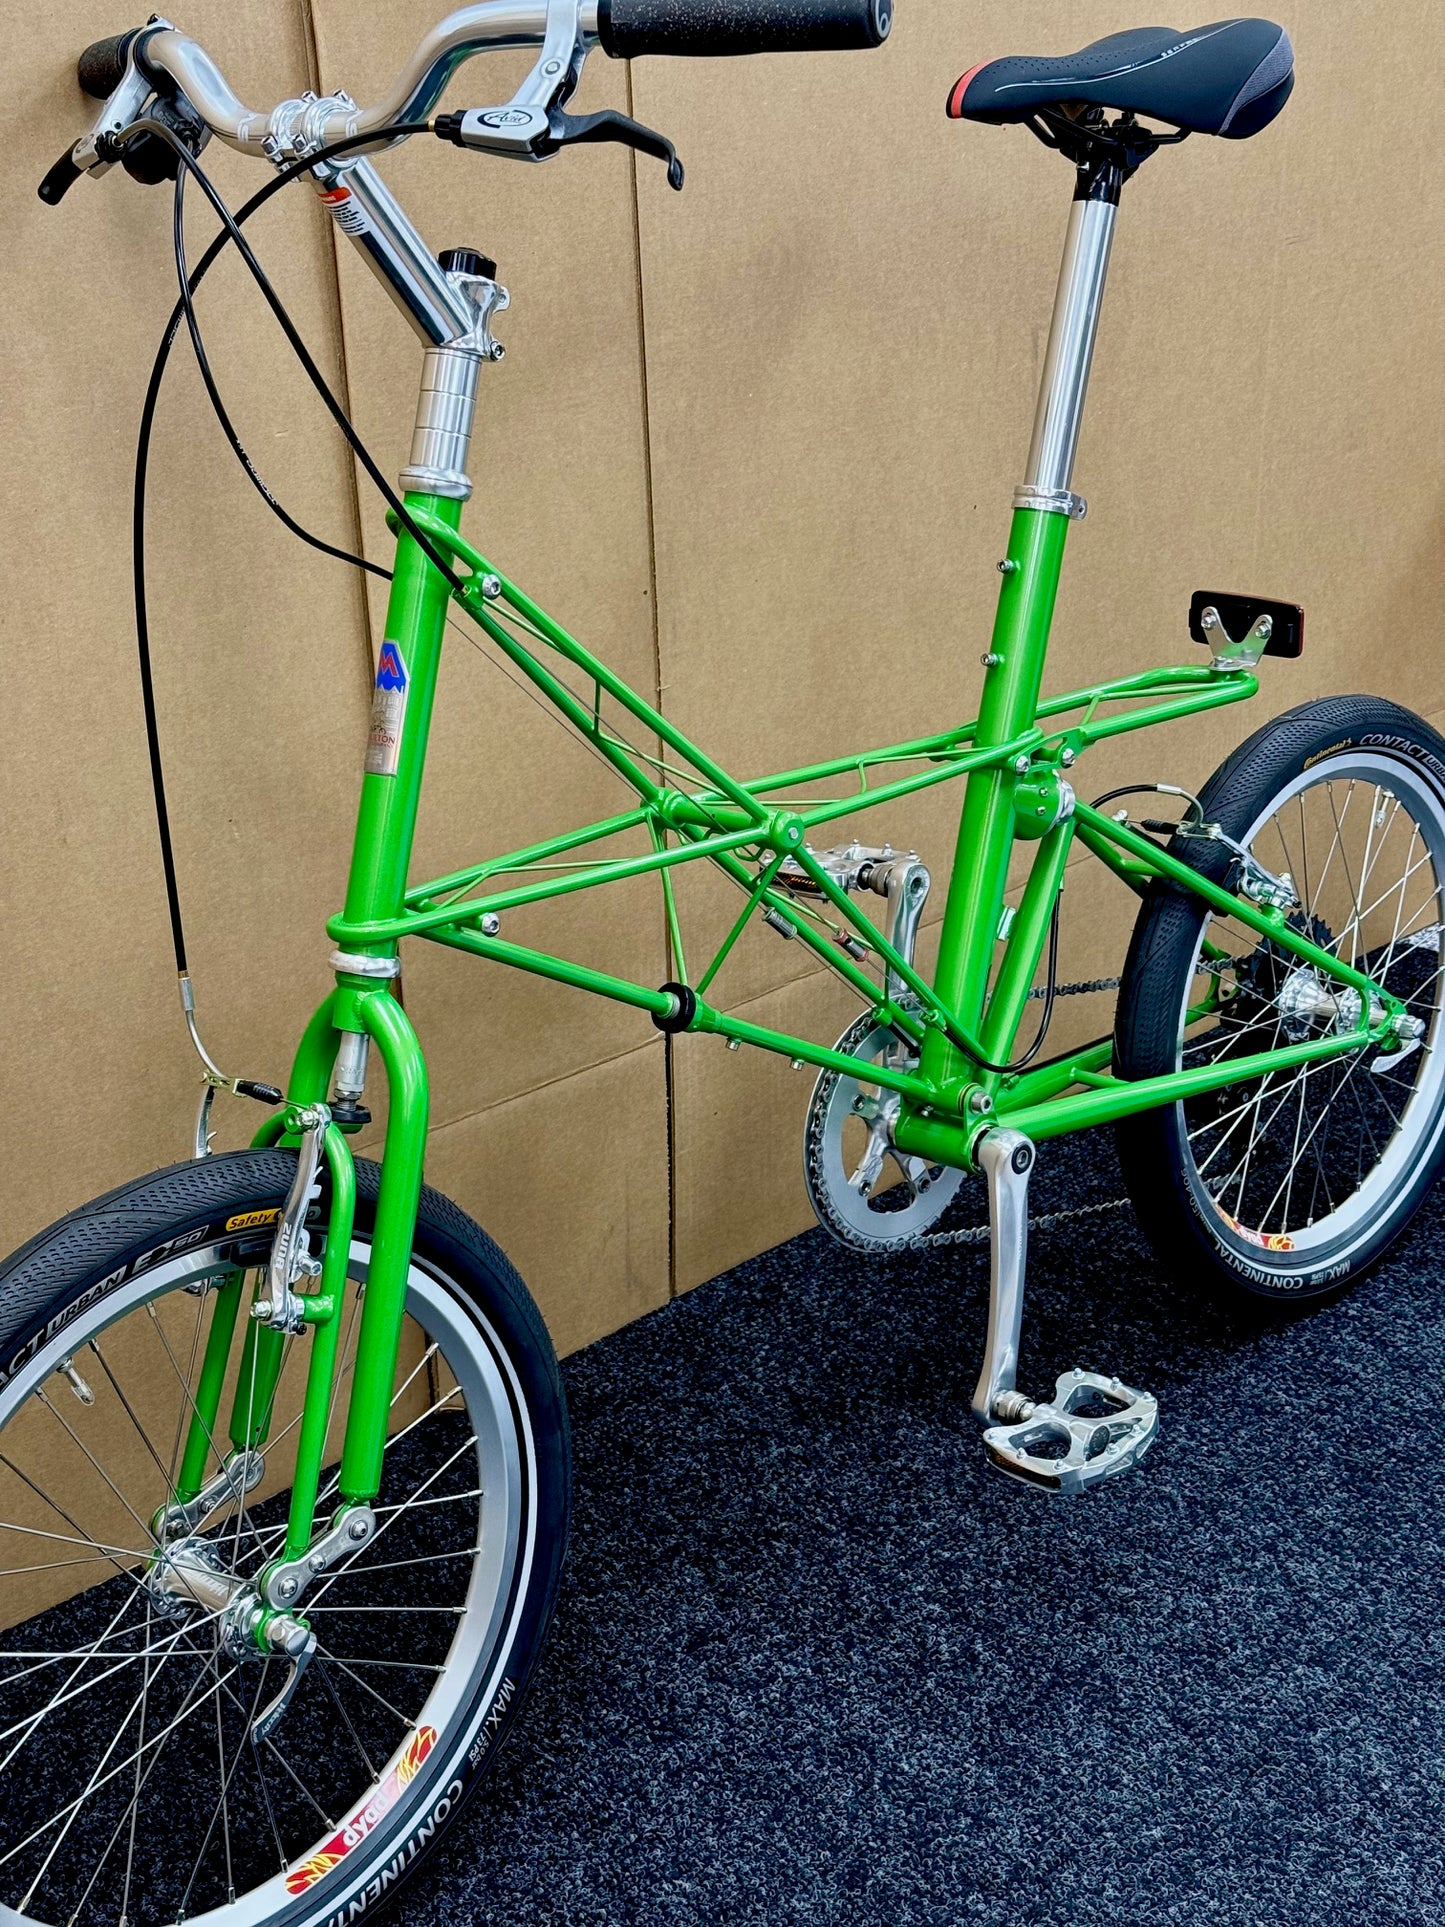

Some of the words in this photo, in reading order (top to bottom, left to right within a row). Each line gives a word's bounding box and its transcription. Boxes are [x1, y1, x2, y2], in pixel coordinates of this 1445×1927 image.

[487, 111, 526, 124] Avid
[1359, 734, 1429, 758] CONTACT
[229, 1212, 272, 1229] Safety
[1214, 1238, 1303, 1289] CONTINENTAL
[53, 1271, 123, 1330] URBAN
[485, 1676, 516, 1731] MAX.
[468, 1743, 480, 1761] PSI
[342, 1790, 389, 1847] dyad
